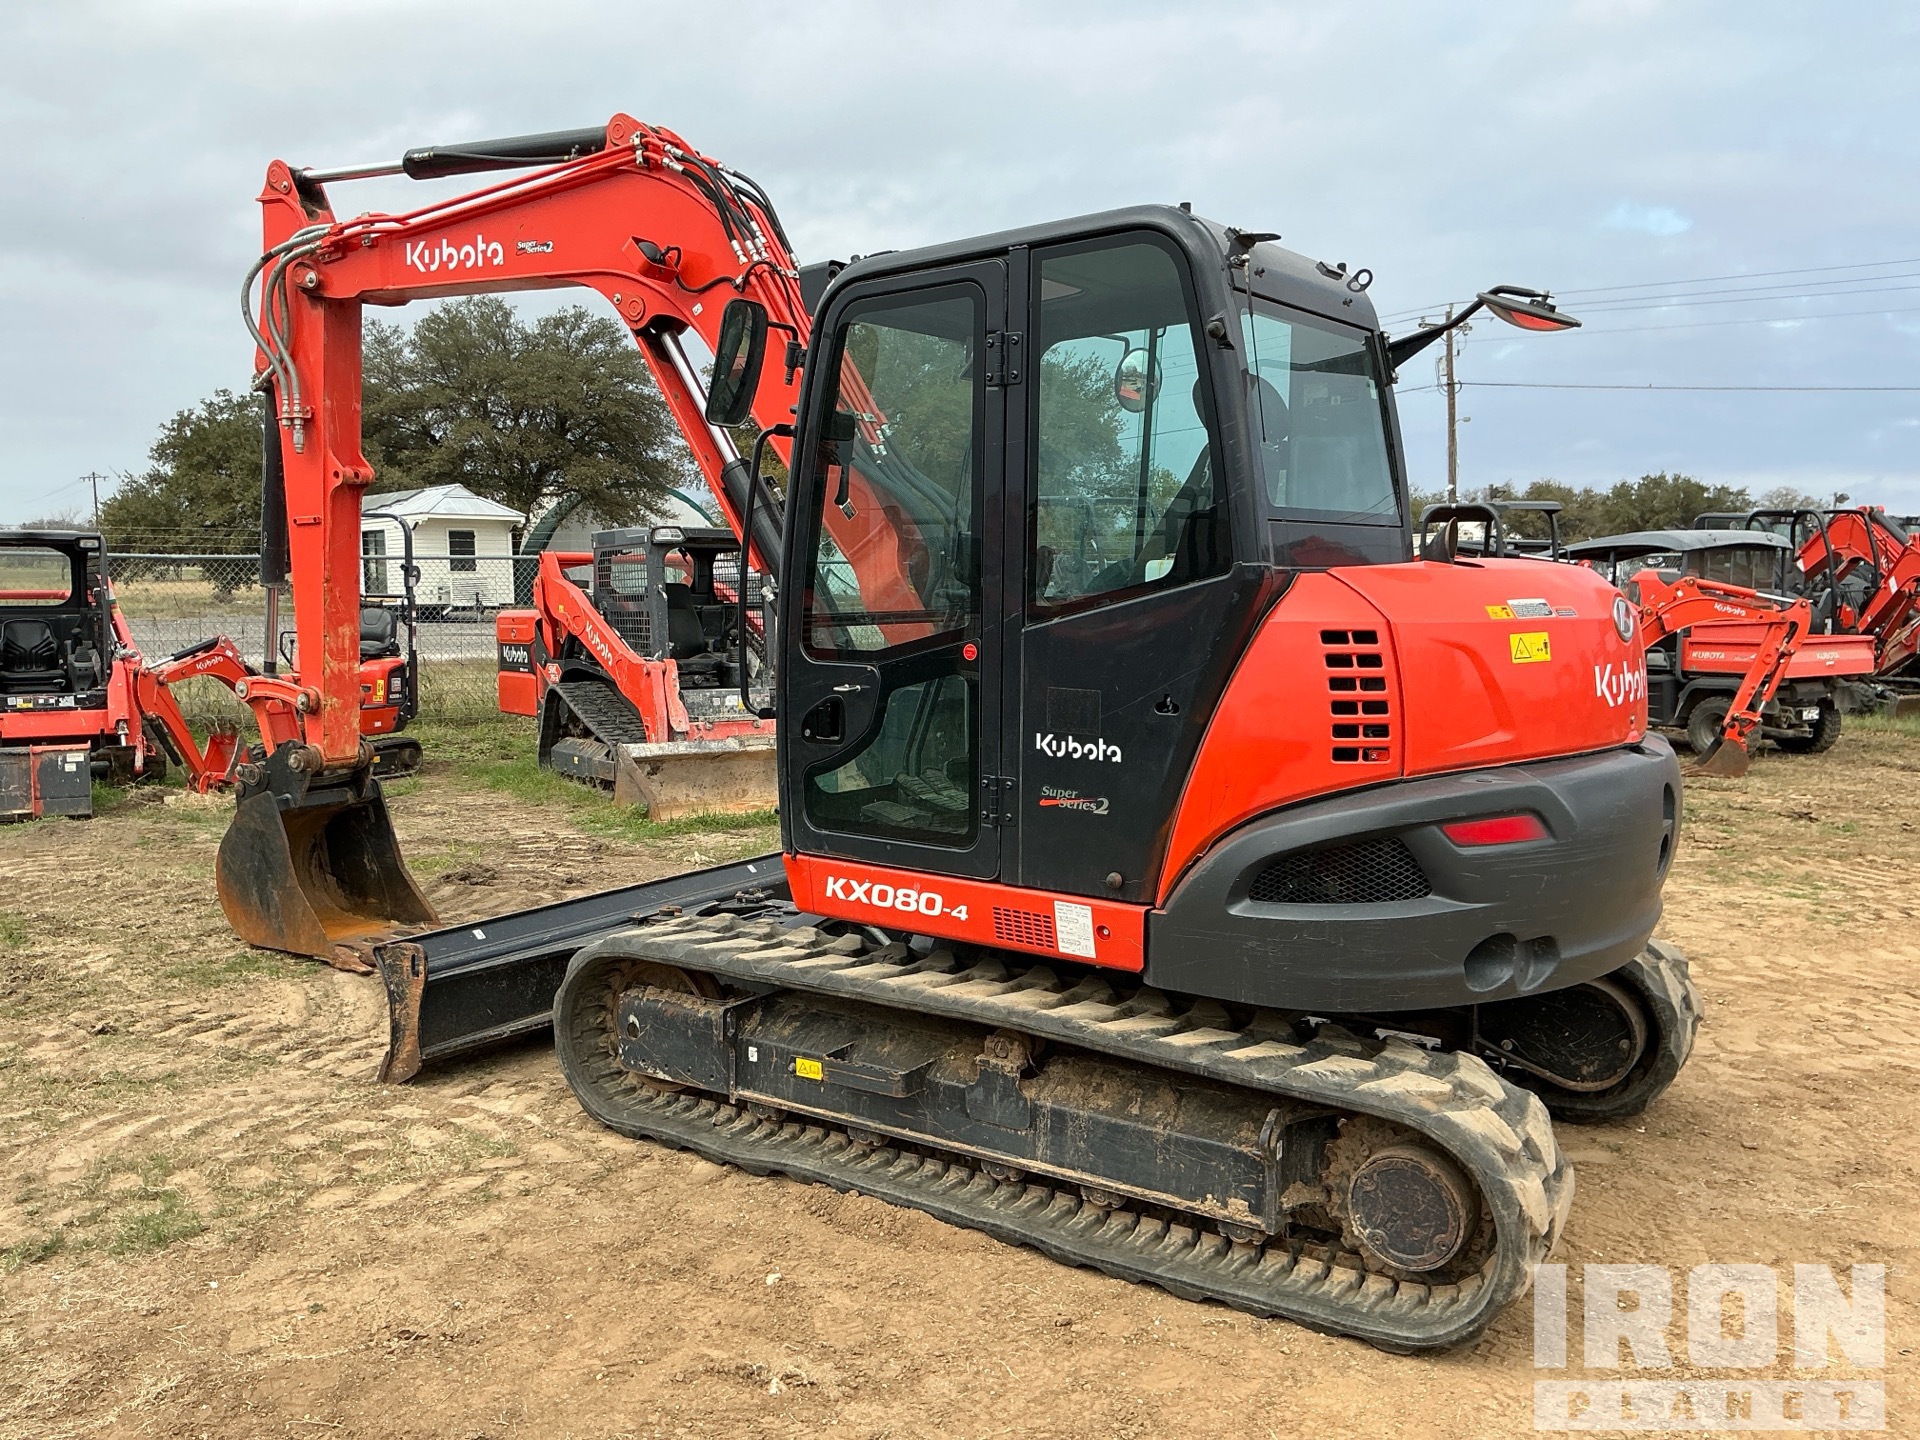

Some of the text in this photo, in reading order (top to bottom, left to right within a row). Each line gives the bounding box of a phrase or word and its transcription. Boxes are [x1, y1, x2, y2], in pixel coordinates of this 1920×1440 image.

[406, 234, 504, 272] Kubota
[517, 240, 537, 250] Super
[1714, 602, 1747, 617] Kubota
[586, 620, 613, 667] Kubota
[195, 655, 224, 670] Kubota
[503, 645, 528, 664] Kubota
[1692, 651, 1725, 660] KUBOTA
[1036, 732, 1122, 763] Kubota
[1041, 785, 1079, 799] Super
[825, 875, 968, 922] KX080-4
